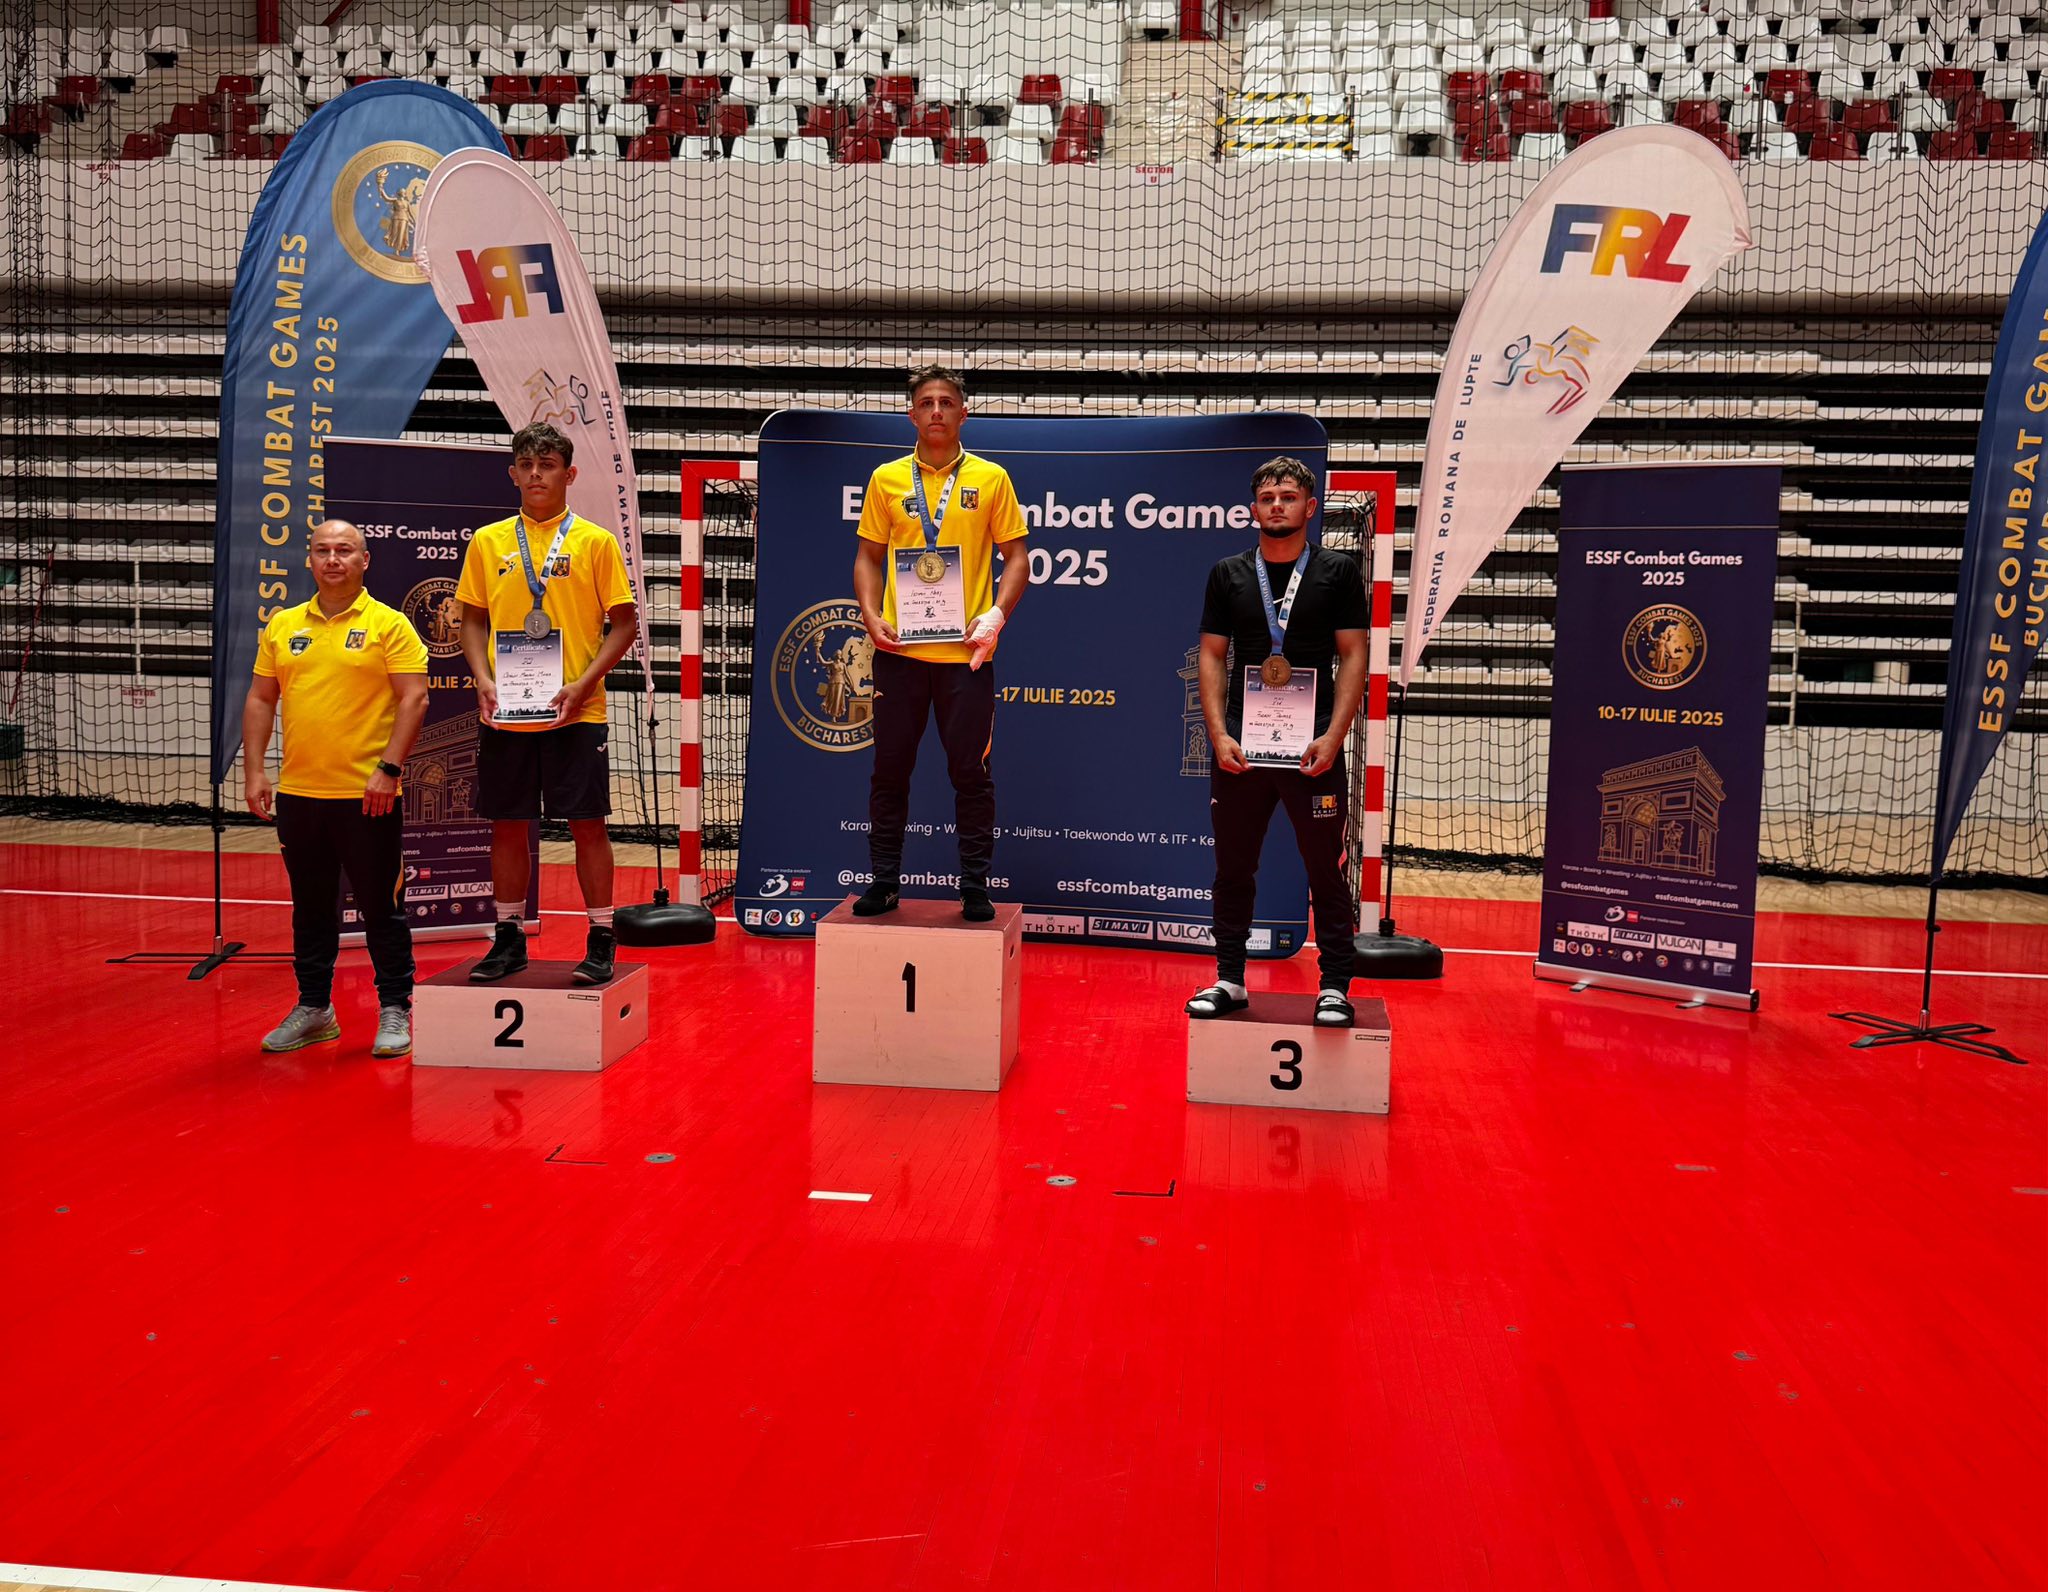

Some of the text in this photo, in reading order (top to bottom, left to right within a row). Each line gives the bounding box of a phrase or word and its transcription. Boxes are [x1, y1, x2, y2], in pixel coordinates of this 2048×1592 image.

[1135, 166, 1174, 174] SECTOR
[1150, 176, 1158, 184] U
[1539, 203, 1692, 284] FRL
[312, 316, 339, 394] 2025
[257, 233, 308, 646] SSF COMBAT GAMES
[1422, 353, 1483, 635] FEDERATIA ROMANA DE LUPTE
[1018, 491, 1115, 529] mbat
[396, 525, 458, 541] Combat
[416, 545, 459, 560] 2025
[1585, 550, 1743, 566] ESSF Combat Games
[996, 547, 1109, 588] 025
[1641, 571, 1685, 586] 2025
[1977, 632, 2012, 733] ESSF
[1995, 428, 2043, 619] COMBAT
[413, 581, 442, 600] COMBAT
[1626, 608, 1703, 647] ESSF COMBAT GAMES 2025
[779, 607, 844, 673] ESSF COMBAT
[427, 675, 459, 689] ULIE
[1636, 669, 1684, 686] BUCHAREST
[994, 686, 1117, 706] -17 IULIE 2025
[1598, 705, 1724, 726] 10-17 IULIE 2025
[796, 714, 875, 745] BUCHAREST
[1312, 795, 1337, 809] FRL
[905, 822, 933, 837] xing
[1012, 826, 1052, 840] Jujitsu
[1063, 828, 1135, 842] Taekwondo
[1137, 832, 1157, 844] WT
[1159, 834, 1169, 845] &
[1172, 834, 1189, 845] ITF
[446, 845, 492, 853] essfcombatg
[408, 883, 493, 895] SIMAVI VULCAN
[1056, 878, 1213, 901] essfcombatgames
[1560, 880, 1629, 896] @essfcombatgames
[1654, 893, 1739, 910] essfcombatgames.com
[1024, 922, 1076, 934] THOTH
[1093, 920, 1148, 932] SIMAVI
[1159, 922, 1212, 941] VULCA
[1570, 928, 1604, 940] THOTH
[1614, 929, 1651, 942] SIMAVI
[1658, 935, 1702, 951] VULCAN
[901, 961, 916, 1013] 1
[494, 998, 524, 1048] 2
[1269, 1039, 1303, 1091] 3
